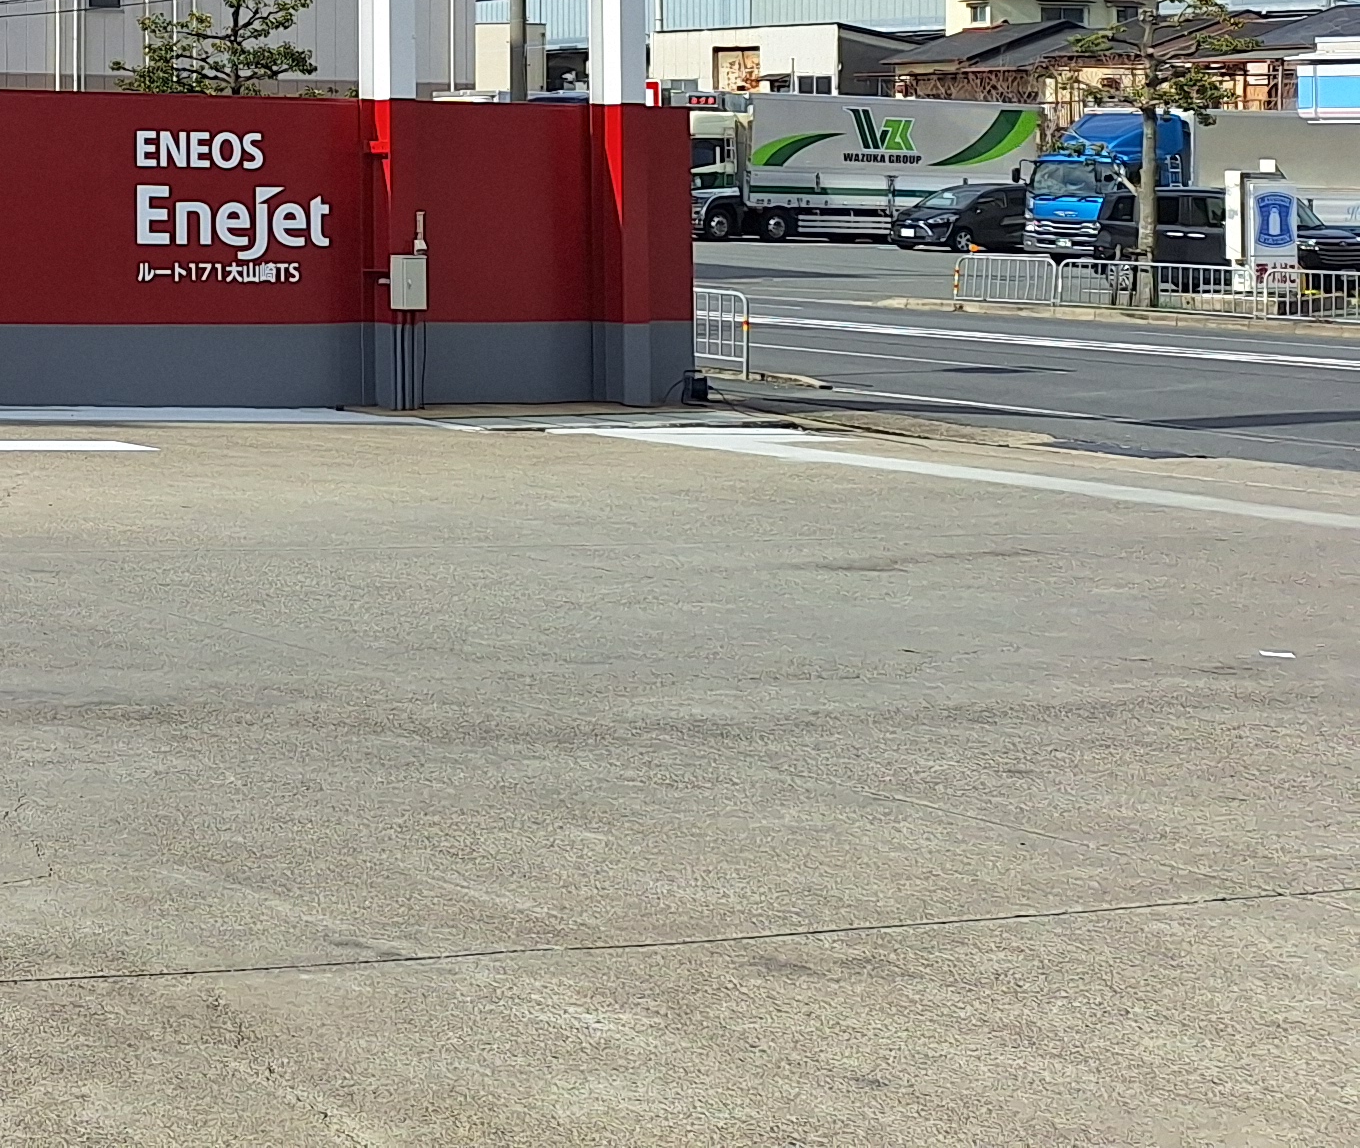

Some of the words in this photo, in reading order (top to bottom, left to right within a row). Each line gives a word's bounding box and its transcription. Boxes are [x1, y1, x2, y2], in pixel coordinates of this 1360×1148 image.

[136, 130, 264, 170] ENEOS
[843, 153, 886, 163] WAZUKA
[889, 154, 922, 164] GROUP
[136, 184, 330, 260] Enejet
[137, 262, 300, 282] ルート171大山崎TS
